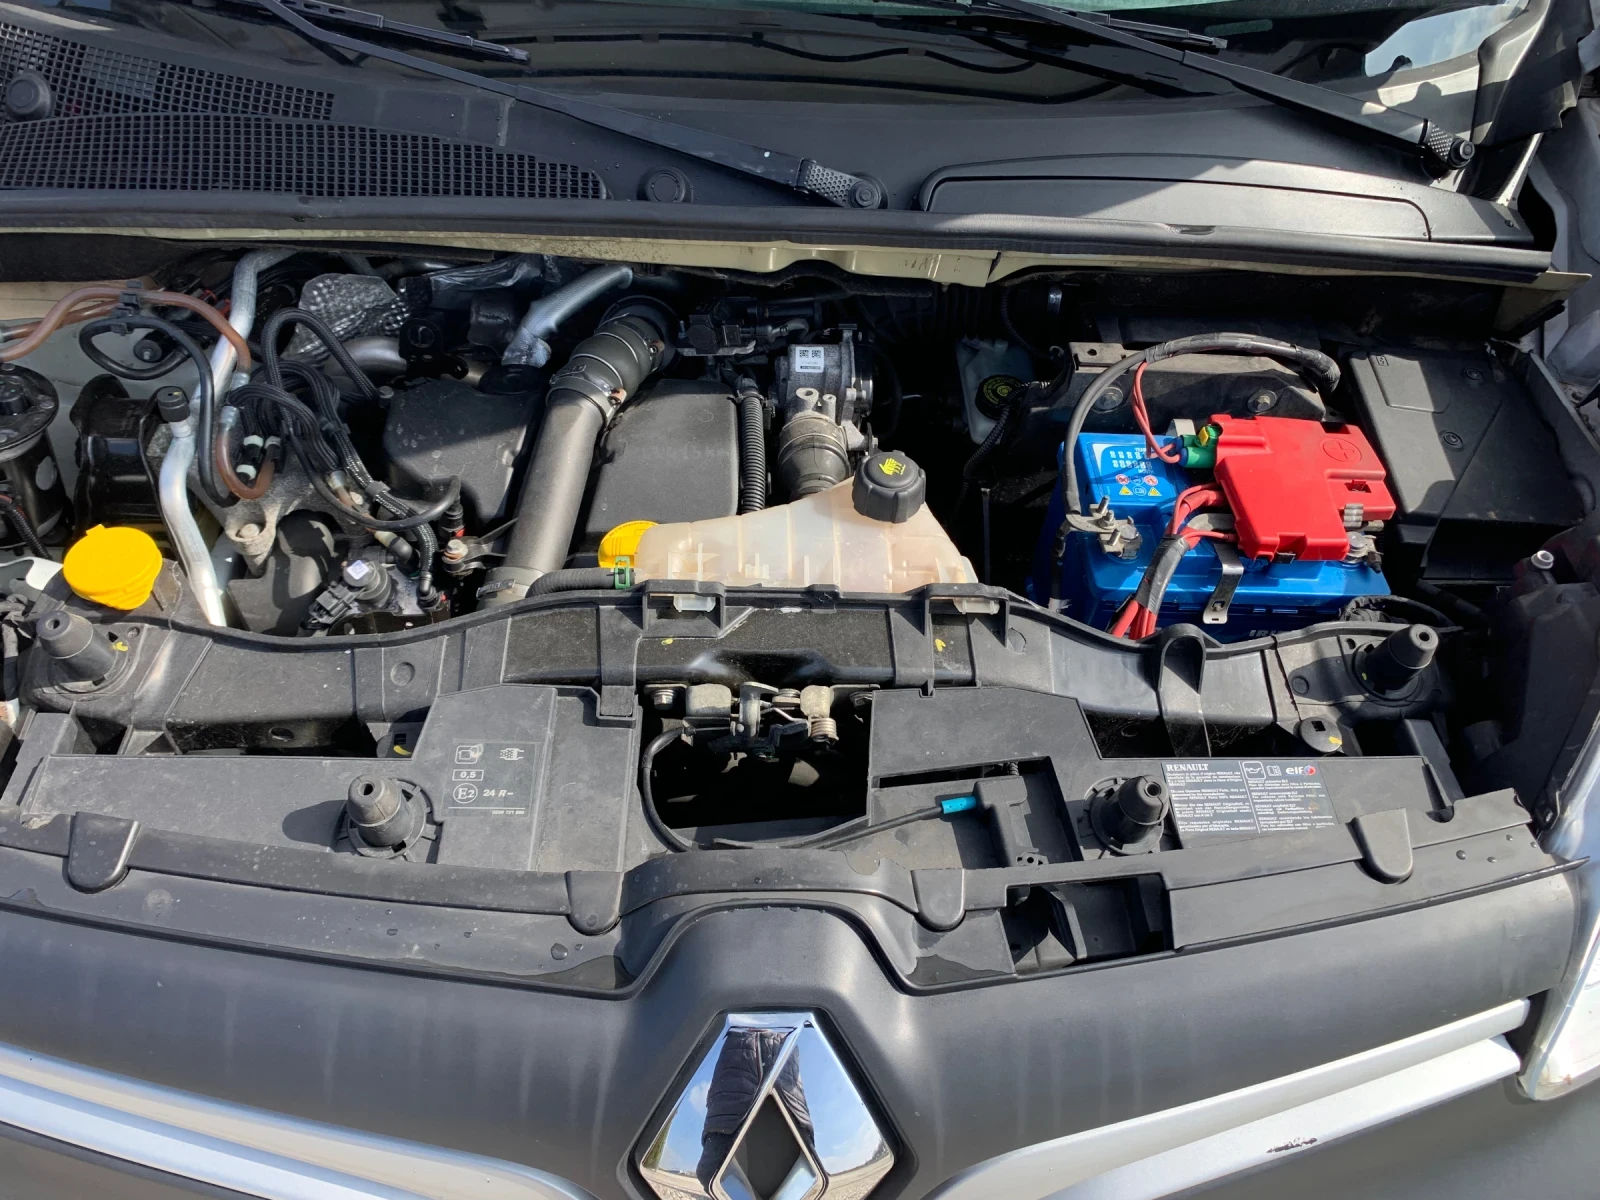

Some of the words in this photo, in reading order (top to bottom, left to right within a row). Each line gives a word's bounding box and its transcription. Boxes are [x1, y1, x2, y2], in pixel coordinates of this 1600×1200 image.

[1166, 763, 1209, 772] RENAULT
[1286, 766, 1304, 775] elf
[460, 771, 476, 779] 0,5
[457, 787, 475, 800] E2
[483, 789, 495, 797] 24
